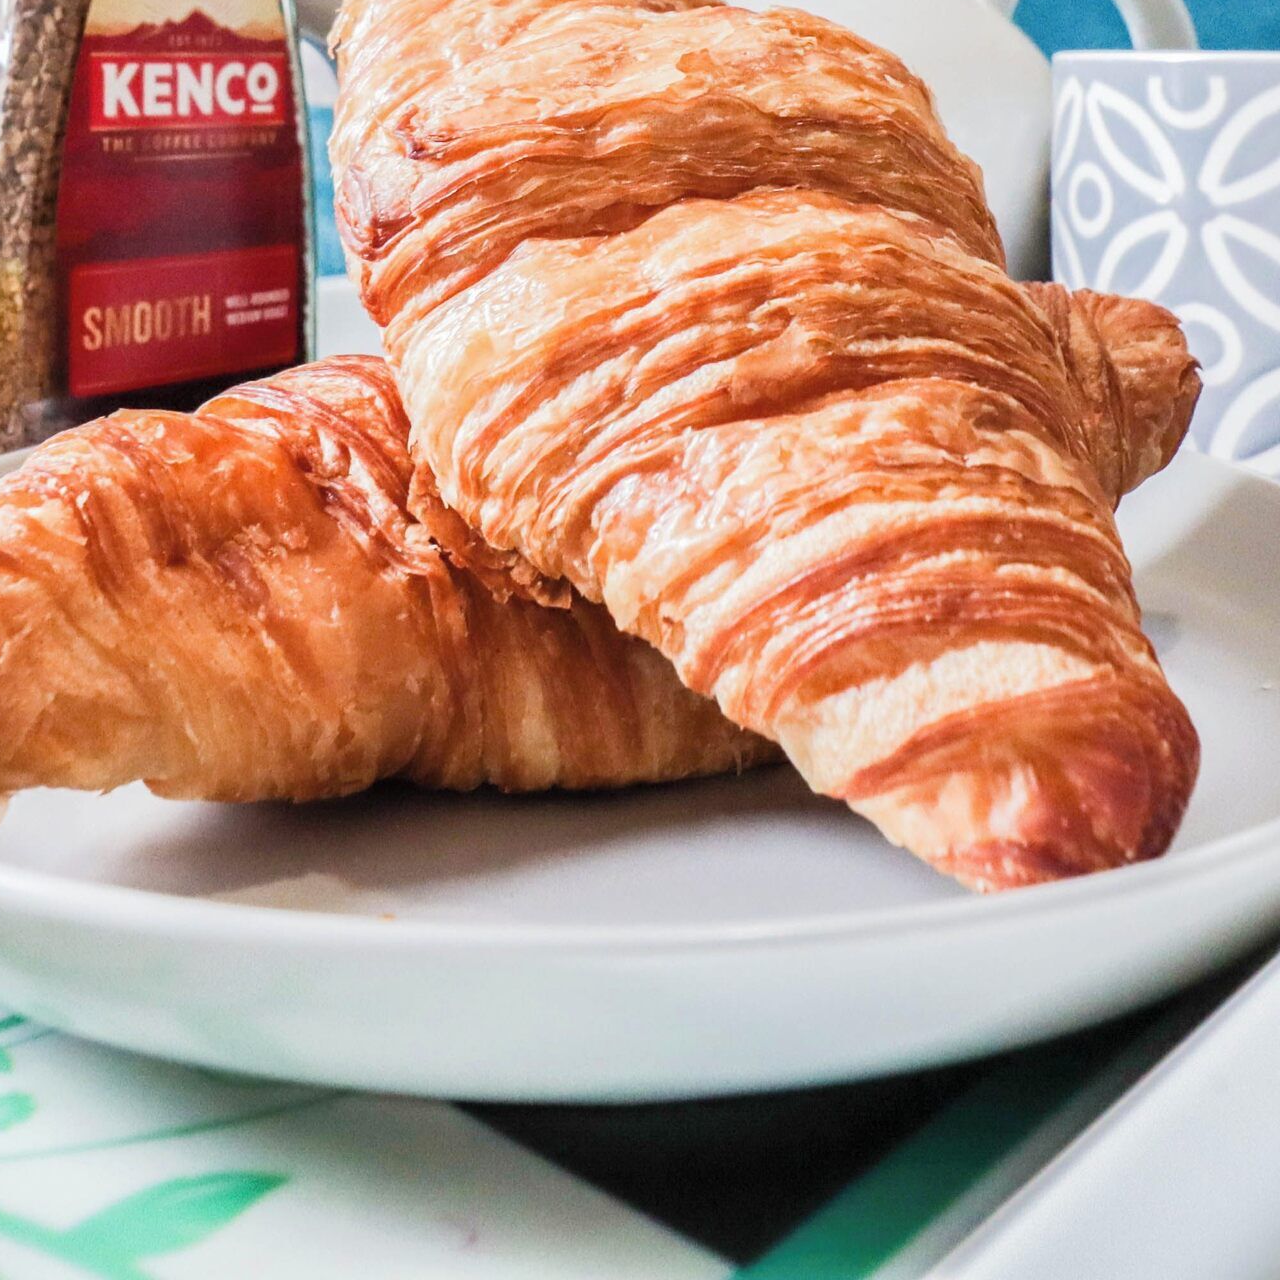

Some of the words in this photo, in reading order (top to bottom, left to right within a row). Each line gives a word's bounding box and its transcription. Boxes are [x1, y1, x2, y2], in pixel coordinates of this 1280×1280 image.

[101, 61, 279, 118] KENCO
[102, 136, 132, 152] THE
[83, 295, 211, 351] SMOOTH
